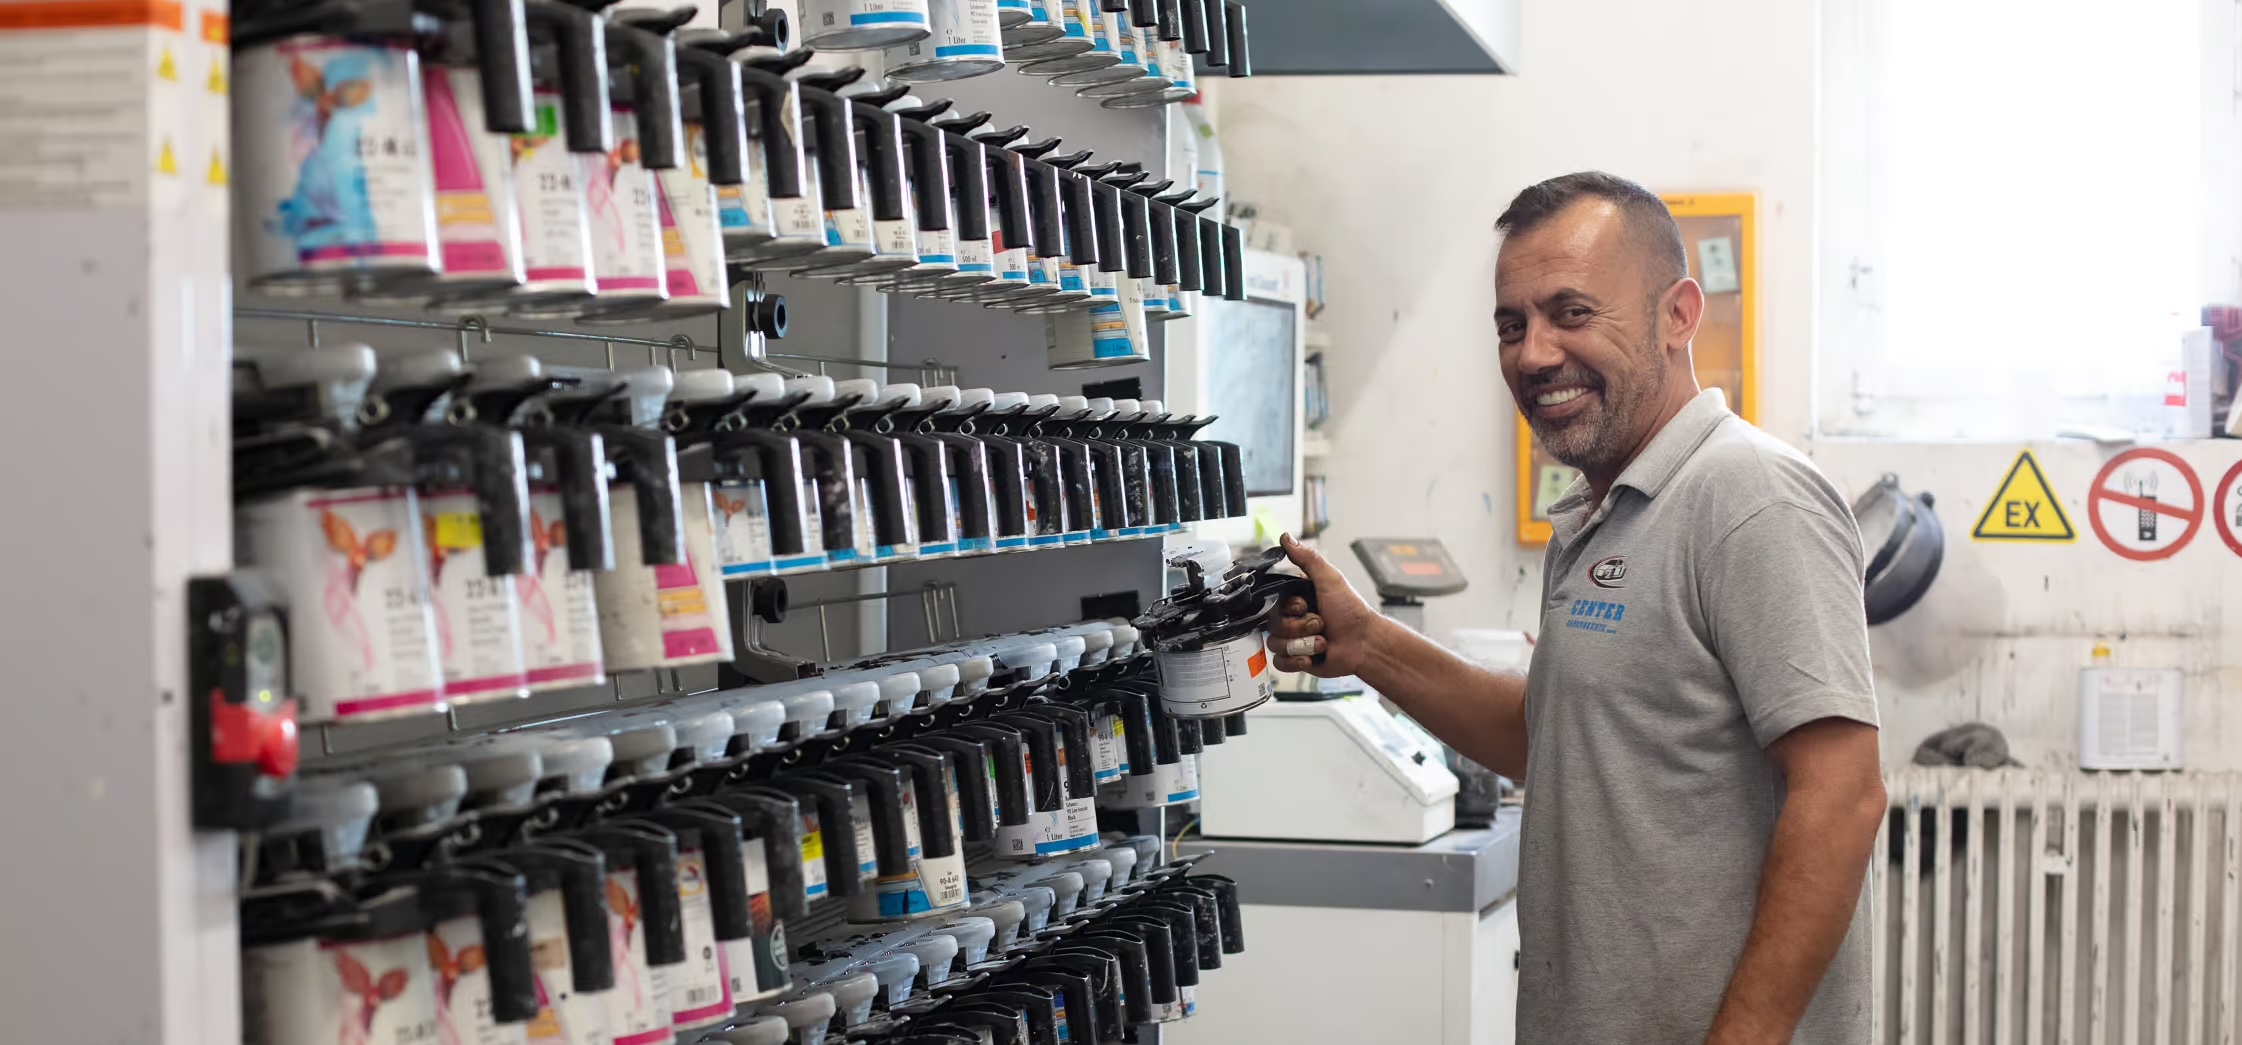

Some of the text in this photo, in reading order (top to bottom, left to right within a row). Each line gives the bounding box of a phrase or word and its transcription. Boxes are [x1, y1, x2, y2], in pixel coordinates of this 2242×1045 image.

[954, 36, 966, 44] Liter
[2006, 501, 2041, 528] EX
[1571, 599, 1626, 621] CENTER
[1051, 833, 1063, 841] Liter
